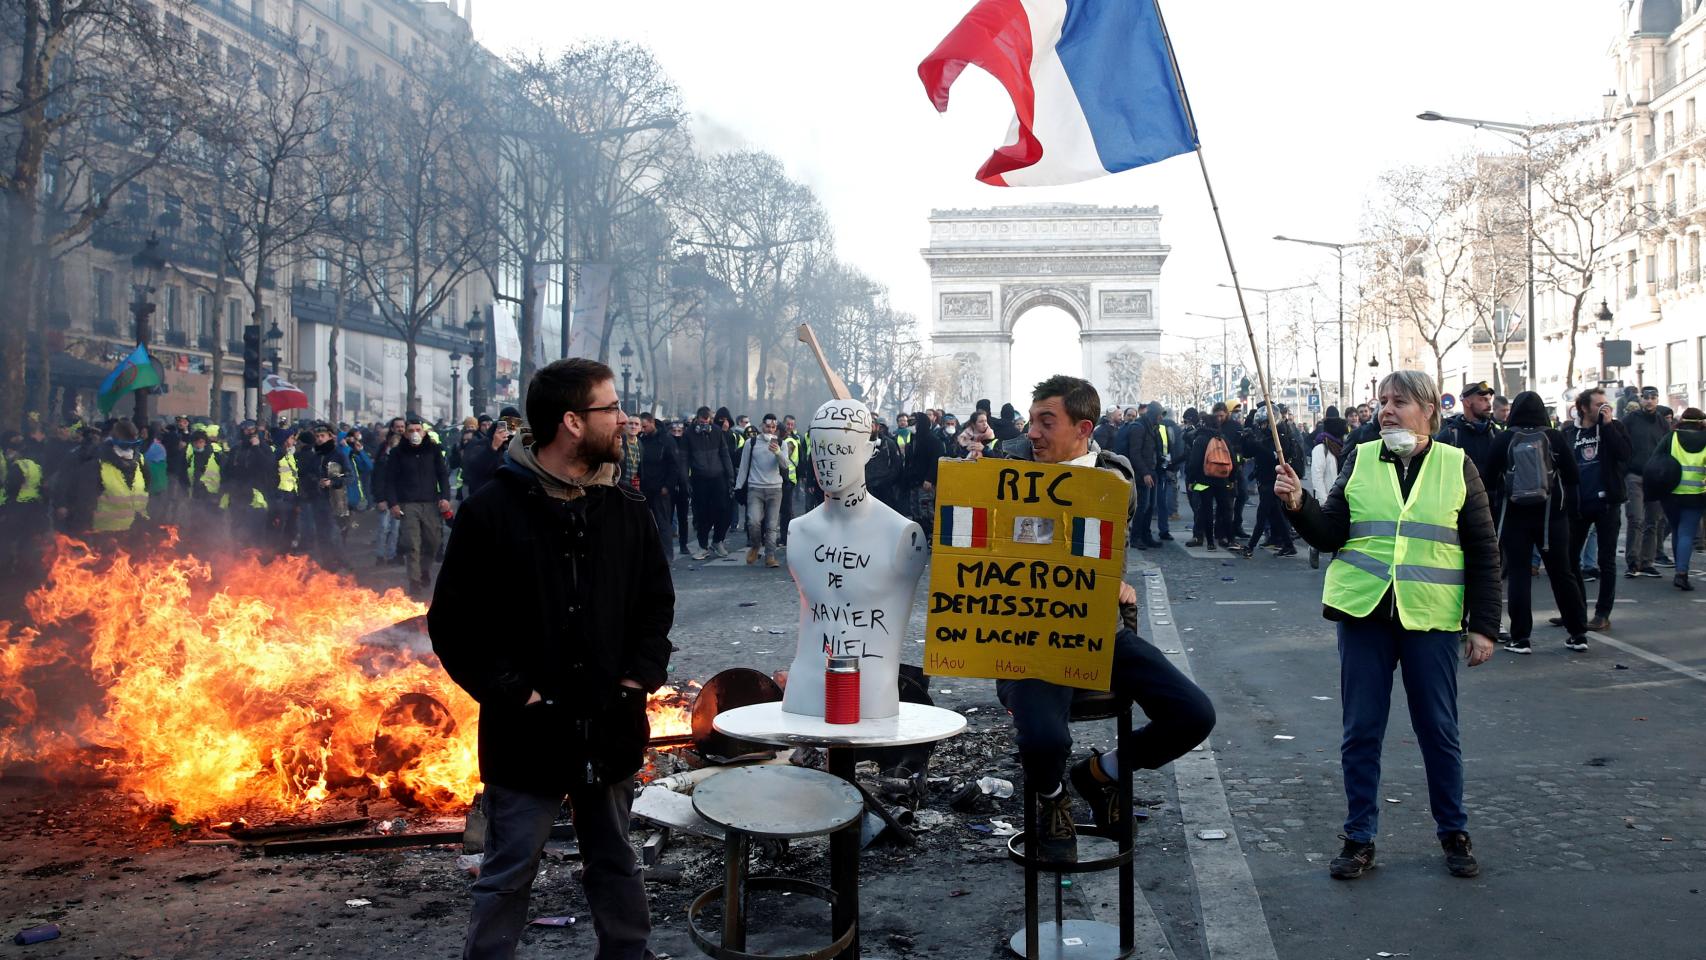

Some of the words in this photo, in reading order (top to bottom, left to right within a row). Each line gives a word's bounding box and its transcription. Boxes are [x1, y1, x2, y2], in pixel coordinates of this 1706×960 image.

[997, 468, 1073, 506] RIC
[828, 572, 843, 588] DE
[957, 560, 1096, 591] MACRON
[930, 591, 1088, 619] DEMISSION
[935, 626, 967, 643] ON
[975, 627, 1040, 646] LACHE
[1048, 631, 1103, 652] RIEN
